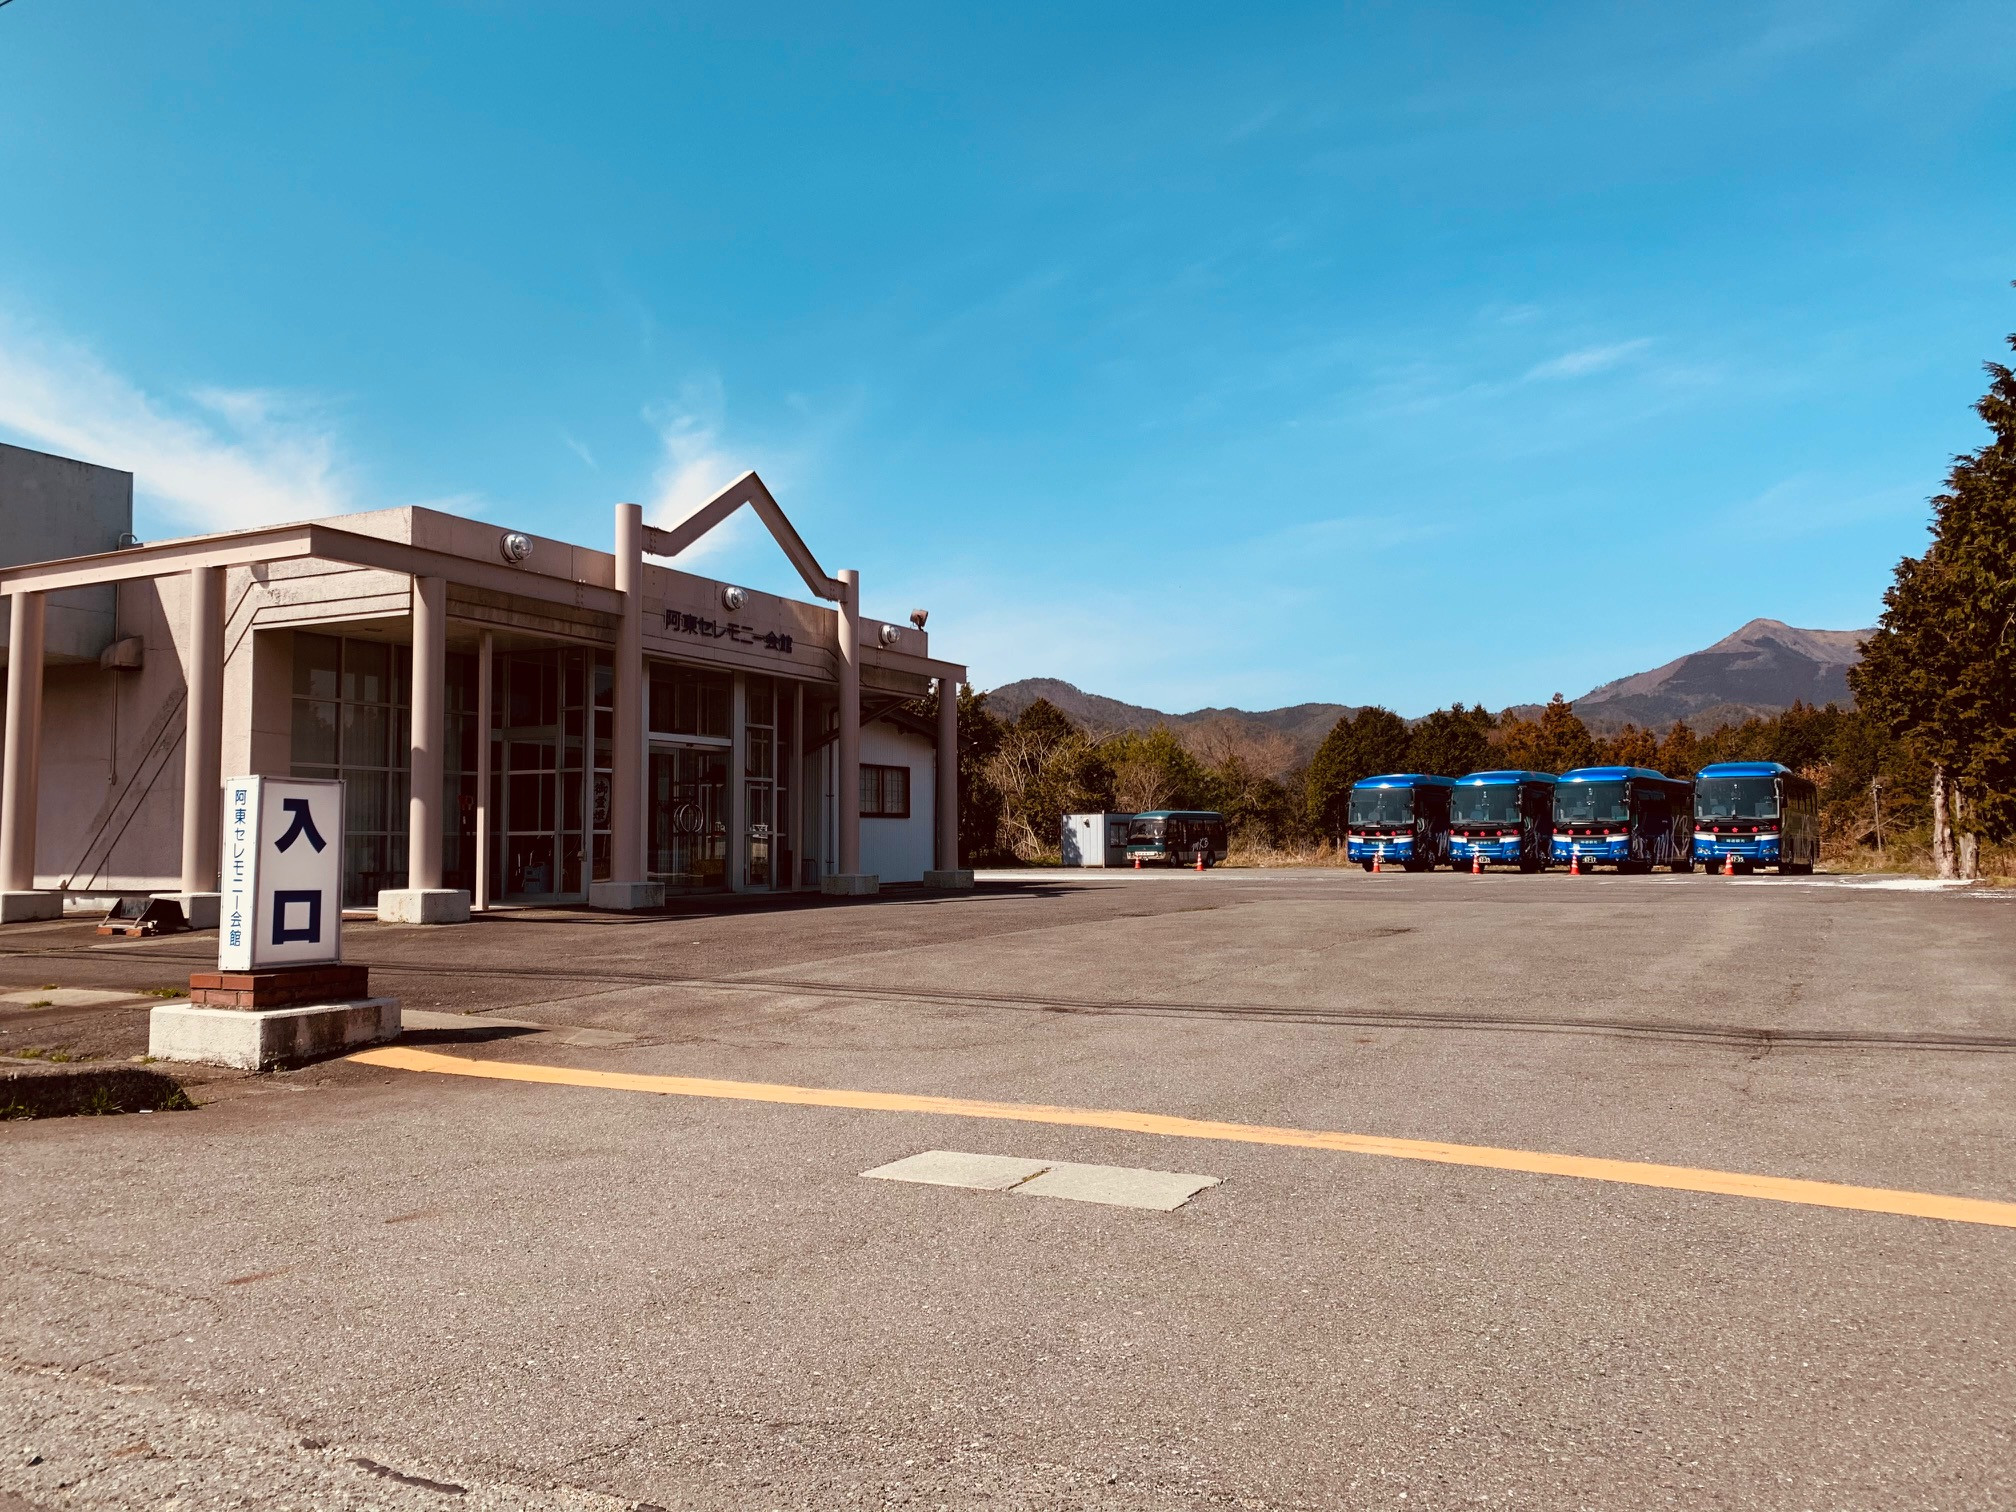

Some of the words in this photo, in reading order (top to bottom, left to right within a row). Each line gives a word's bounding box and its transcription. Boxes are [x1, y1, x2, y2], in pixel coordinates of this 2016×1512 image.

[664, 609, 793, 654] 阿東セレモニー会館
[229, 789, 247, 947] 阿東セレモニー会館
[272, 798, 327, 945] 入口
